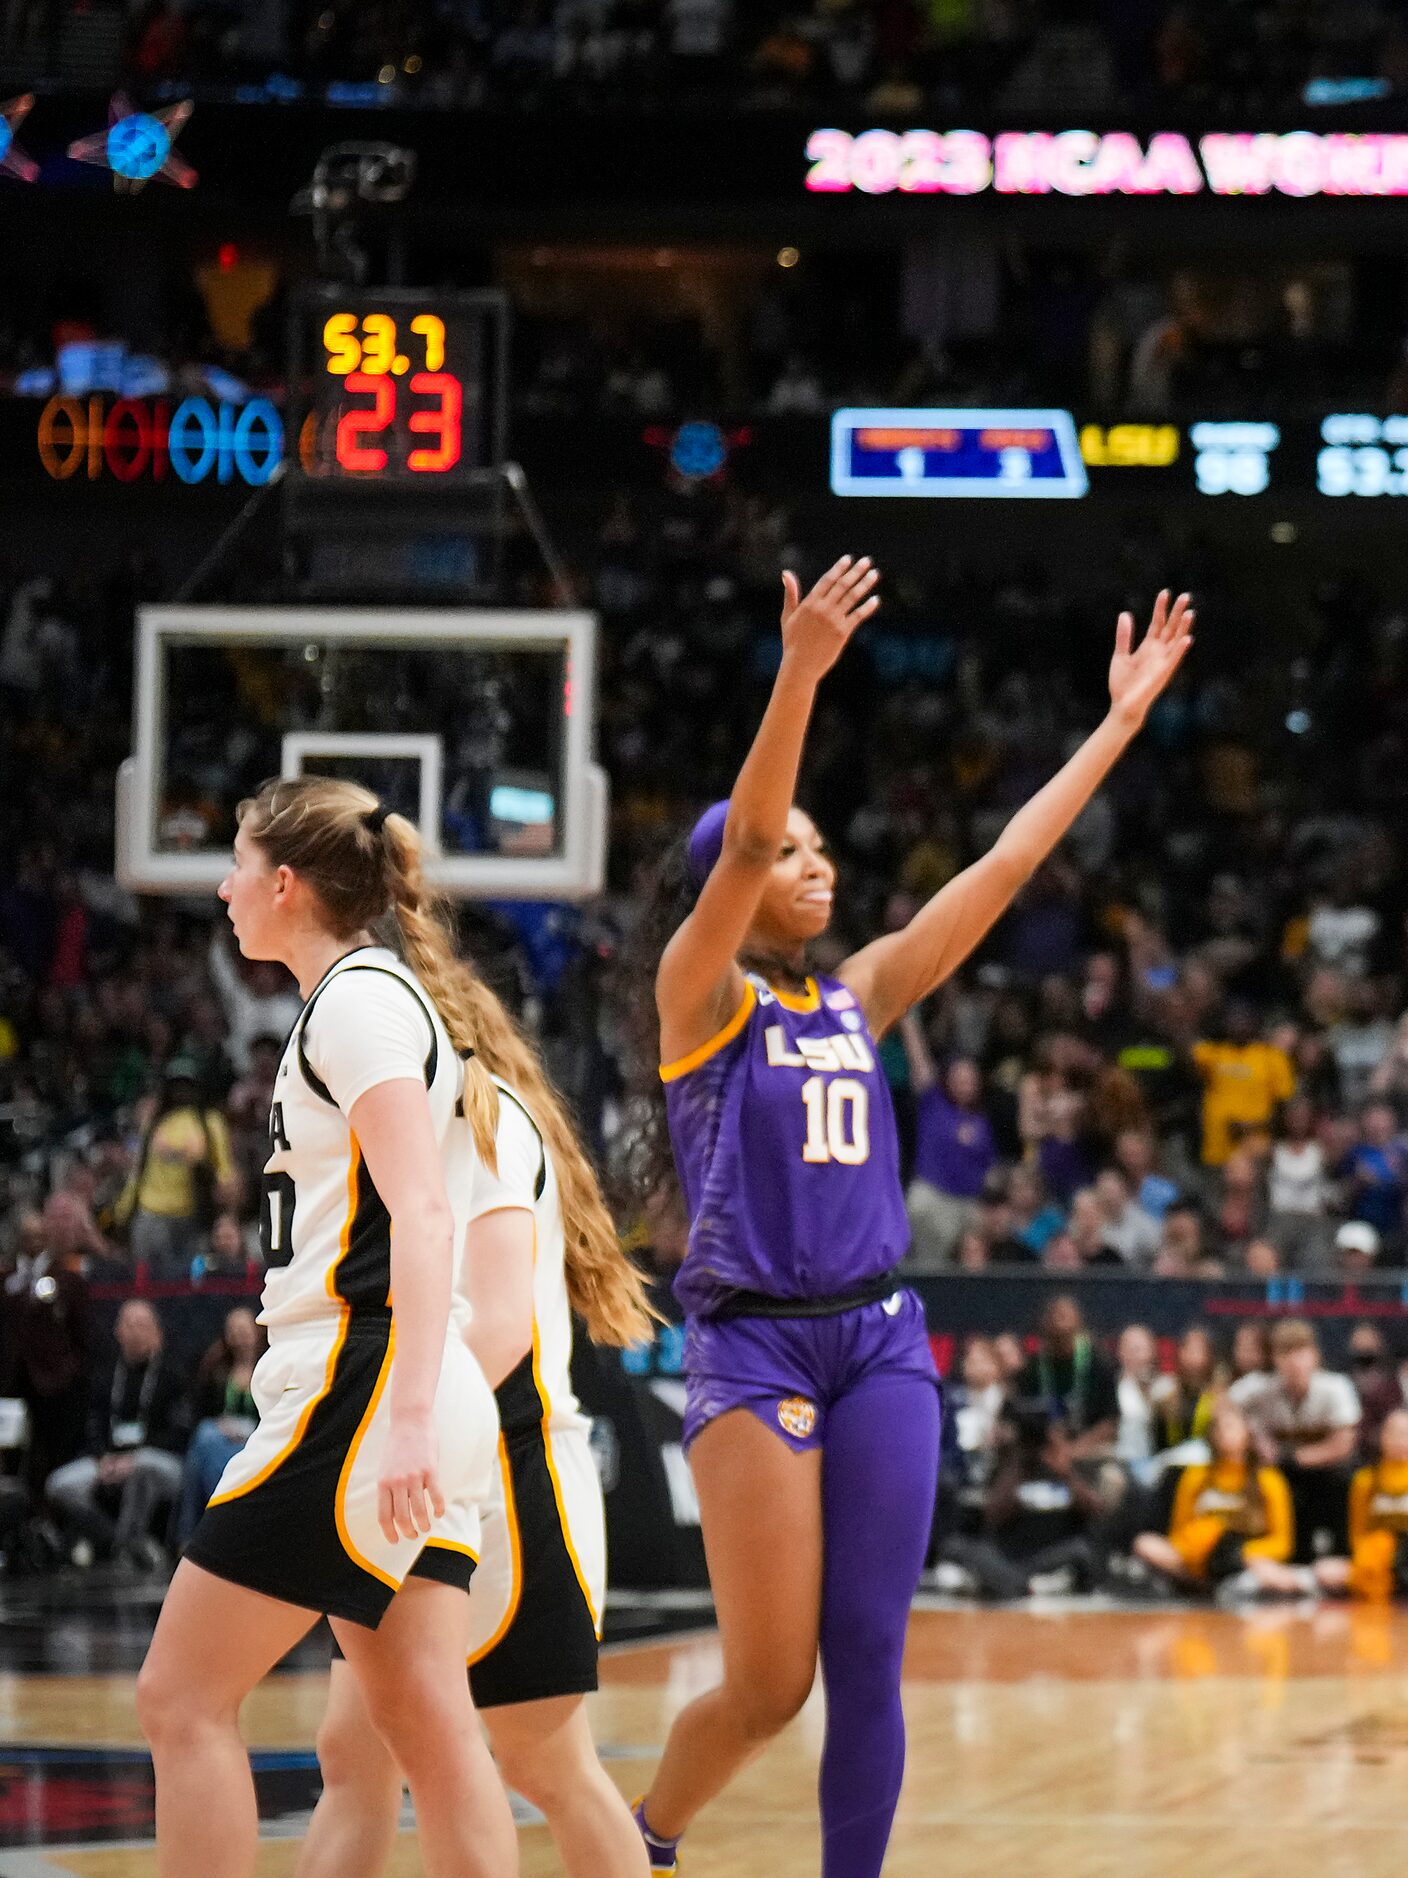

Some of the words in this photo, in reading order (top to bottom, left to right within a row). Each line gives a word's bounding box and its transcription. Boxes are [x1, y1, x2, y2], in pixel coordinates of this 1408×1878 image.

[805, 129, 993, 194] 2023
[993, 130, 1201, 195] NCAA
[323, 312, 446, 375] 53.7
[336, 371, 463, 472] 23
[1079, 423, 1180, 467] LSU
[764, 1024, 875, 1073] LSU
[801, 1075, 870, 1166] 10
